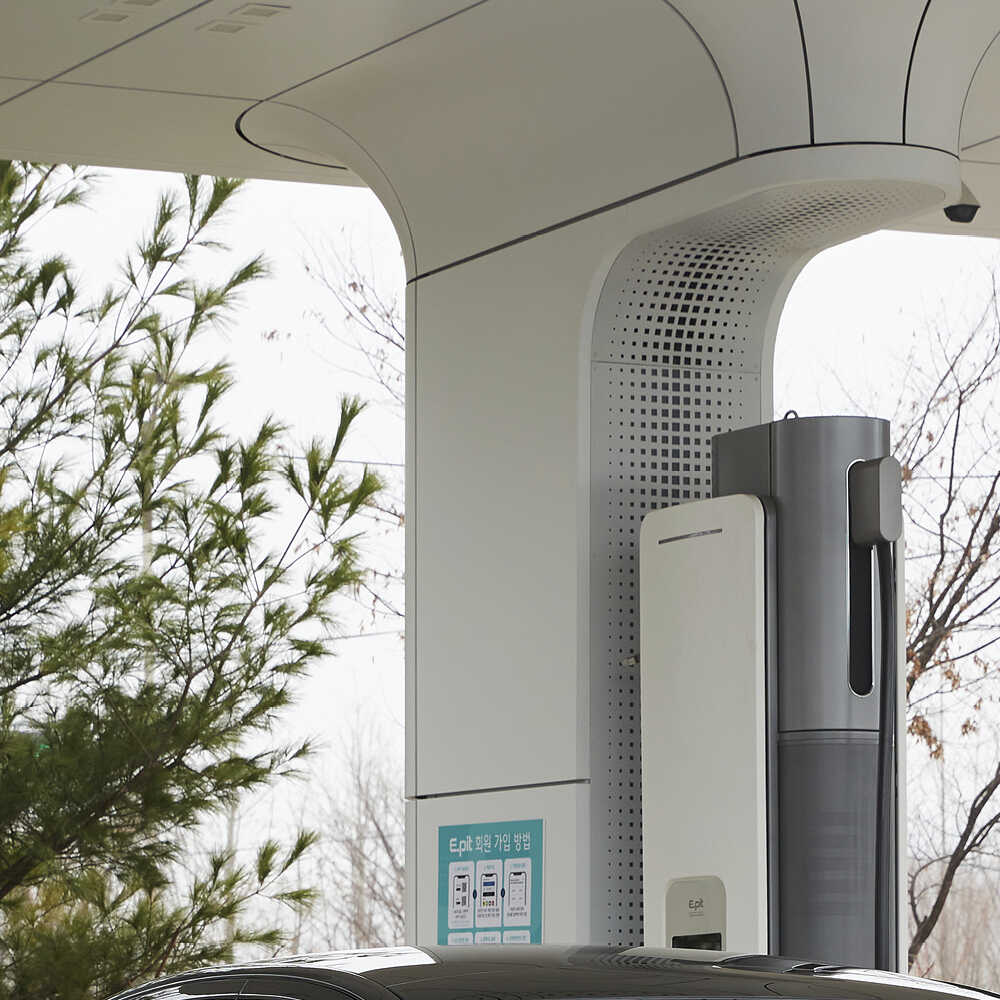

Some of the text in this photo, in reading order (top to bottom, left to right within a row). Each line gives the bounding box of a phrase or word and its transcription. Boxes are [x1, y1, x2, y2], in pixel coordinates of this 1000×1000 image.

[475, 833, 492, 853] 회원
[494, 832, 511, 852] 가입
[513, 831, 531, 852] 방법
